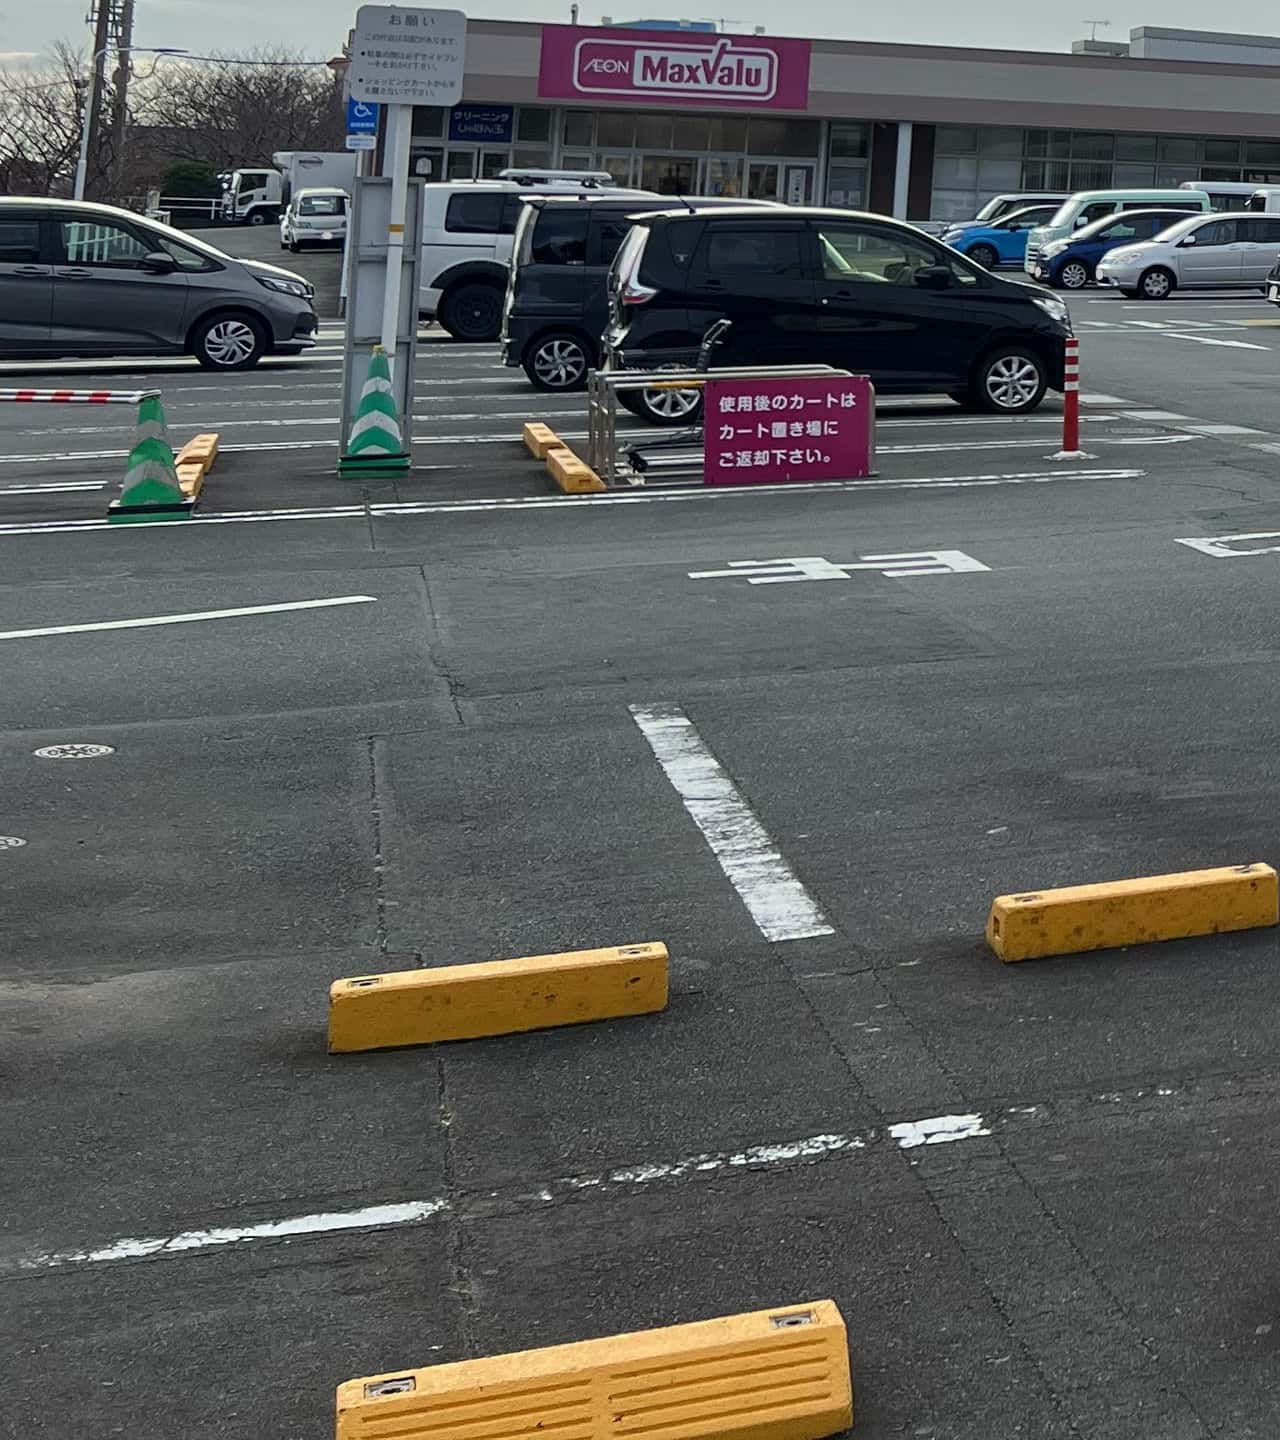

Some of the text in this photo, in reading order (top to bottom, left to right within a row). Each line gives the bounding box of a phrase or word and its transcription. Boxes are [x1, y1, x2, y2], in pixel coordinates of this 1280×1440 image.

[641, 44, 762, 87] MaxValu
[719, 392, 857, 413] 使用後のカートは
[719, 420, 839, 440] カート置き場に
[719, 448, 831, 468] ご返却下さい。
